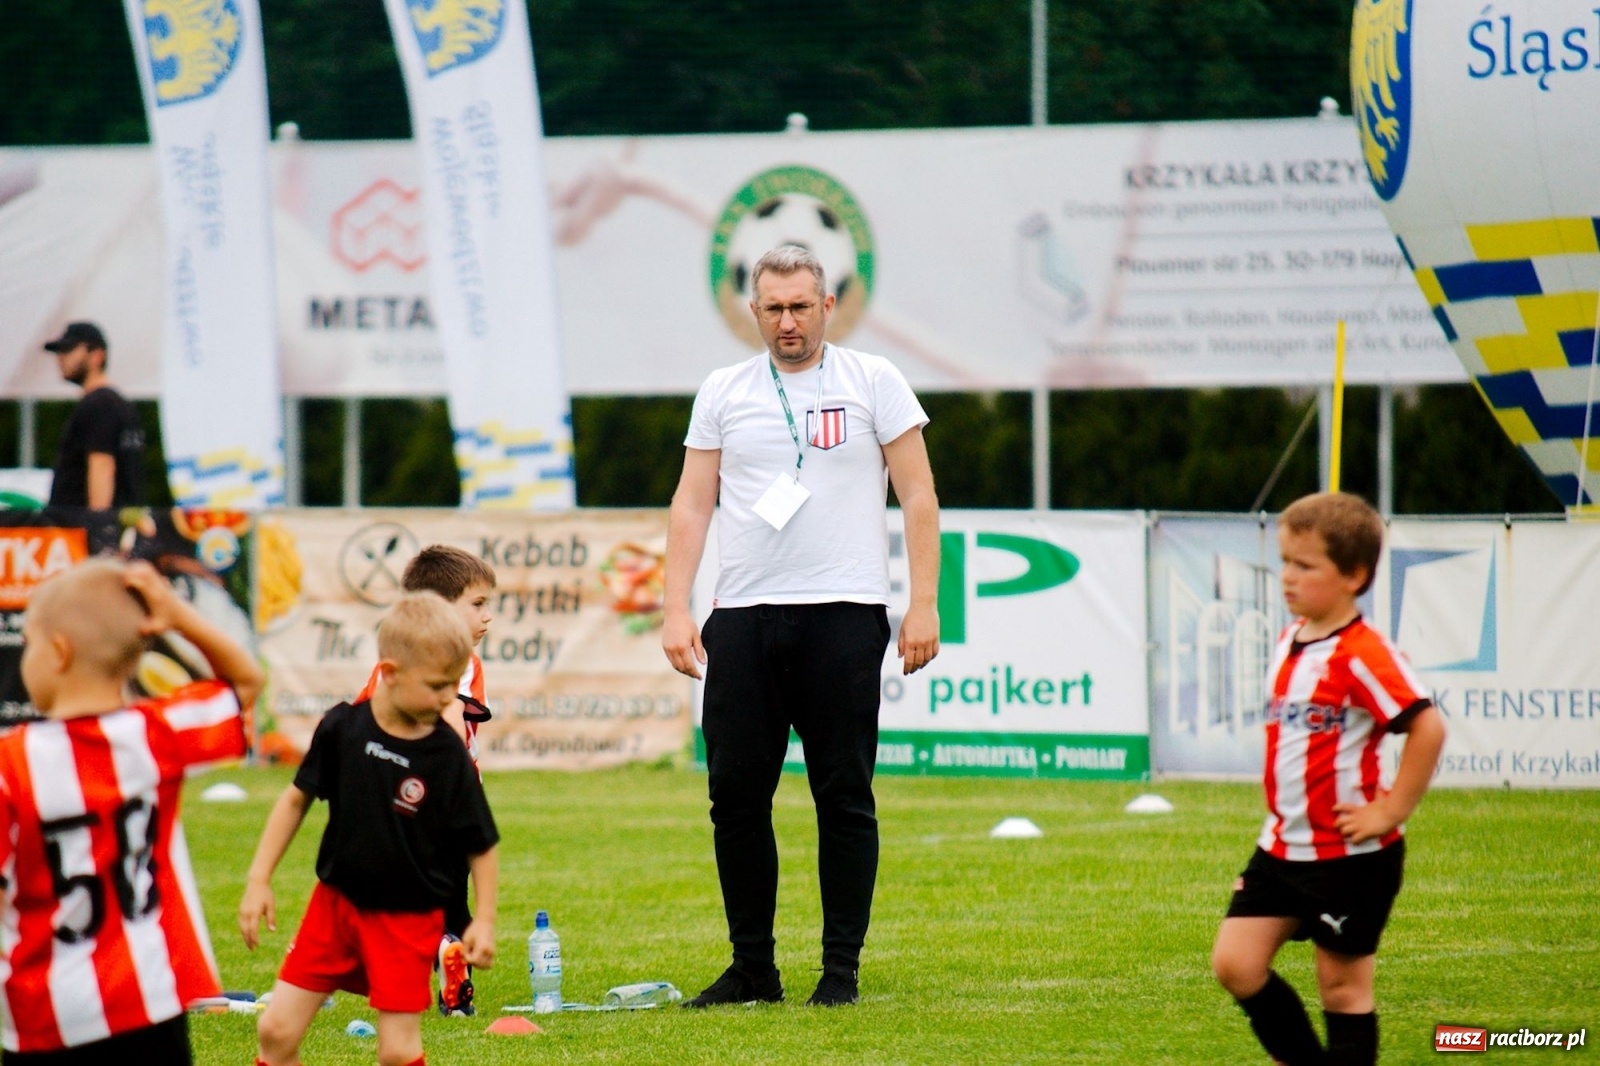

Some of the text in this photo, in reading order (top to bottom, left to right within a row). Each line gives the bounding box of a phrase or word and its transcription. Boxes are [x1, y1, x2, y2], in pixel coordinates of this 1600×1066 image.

[1284, 157, 1372, 186] KRZY
[308, 298, 435, 329] META
[480, 534, 589, 567] Kebab
[497, 580, 582, 623] rytki
[482, 629, 563, 672] Lody
[929, 665, 1092, 715] pajkert
